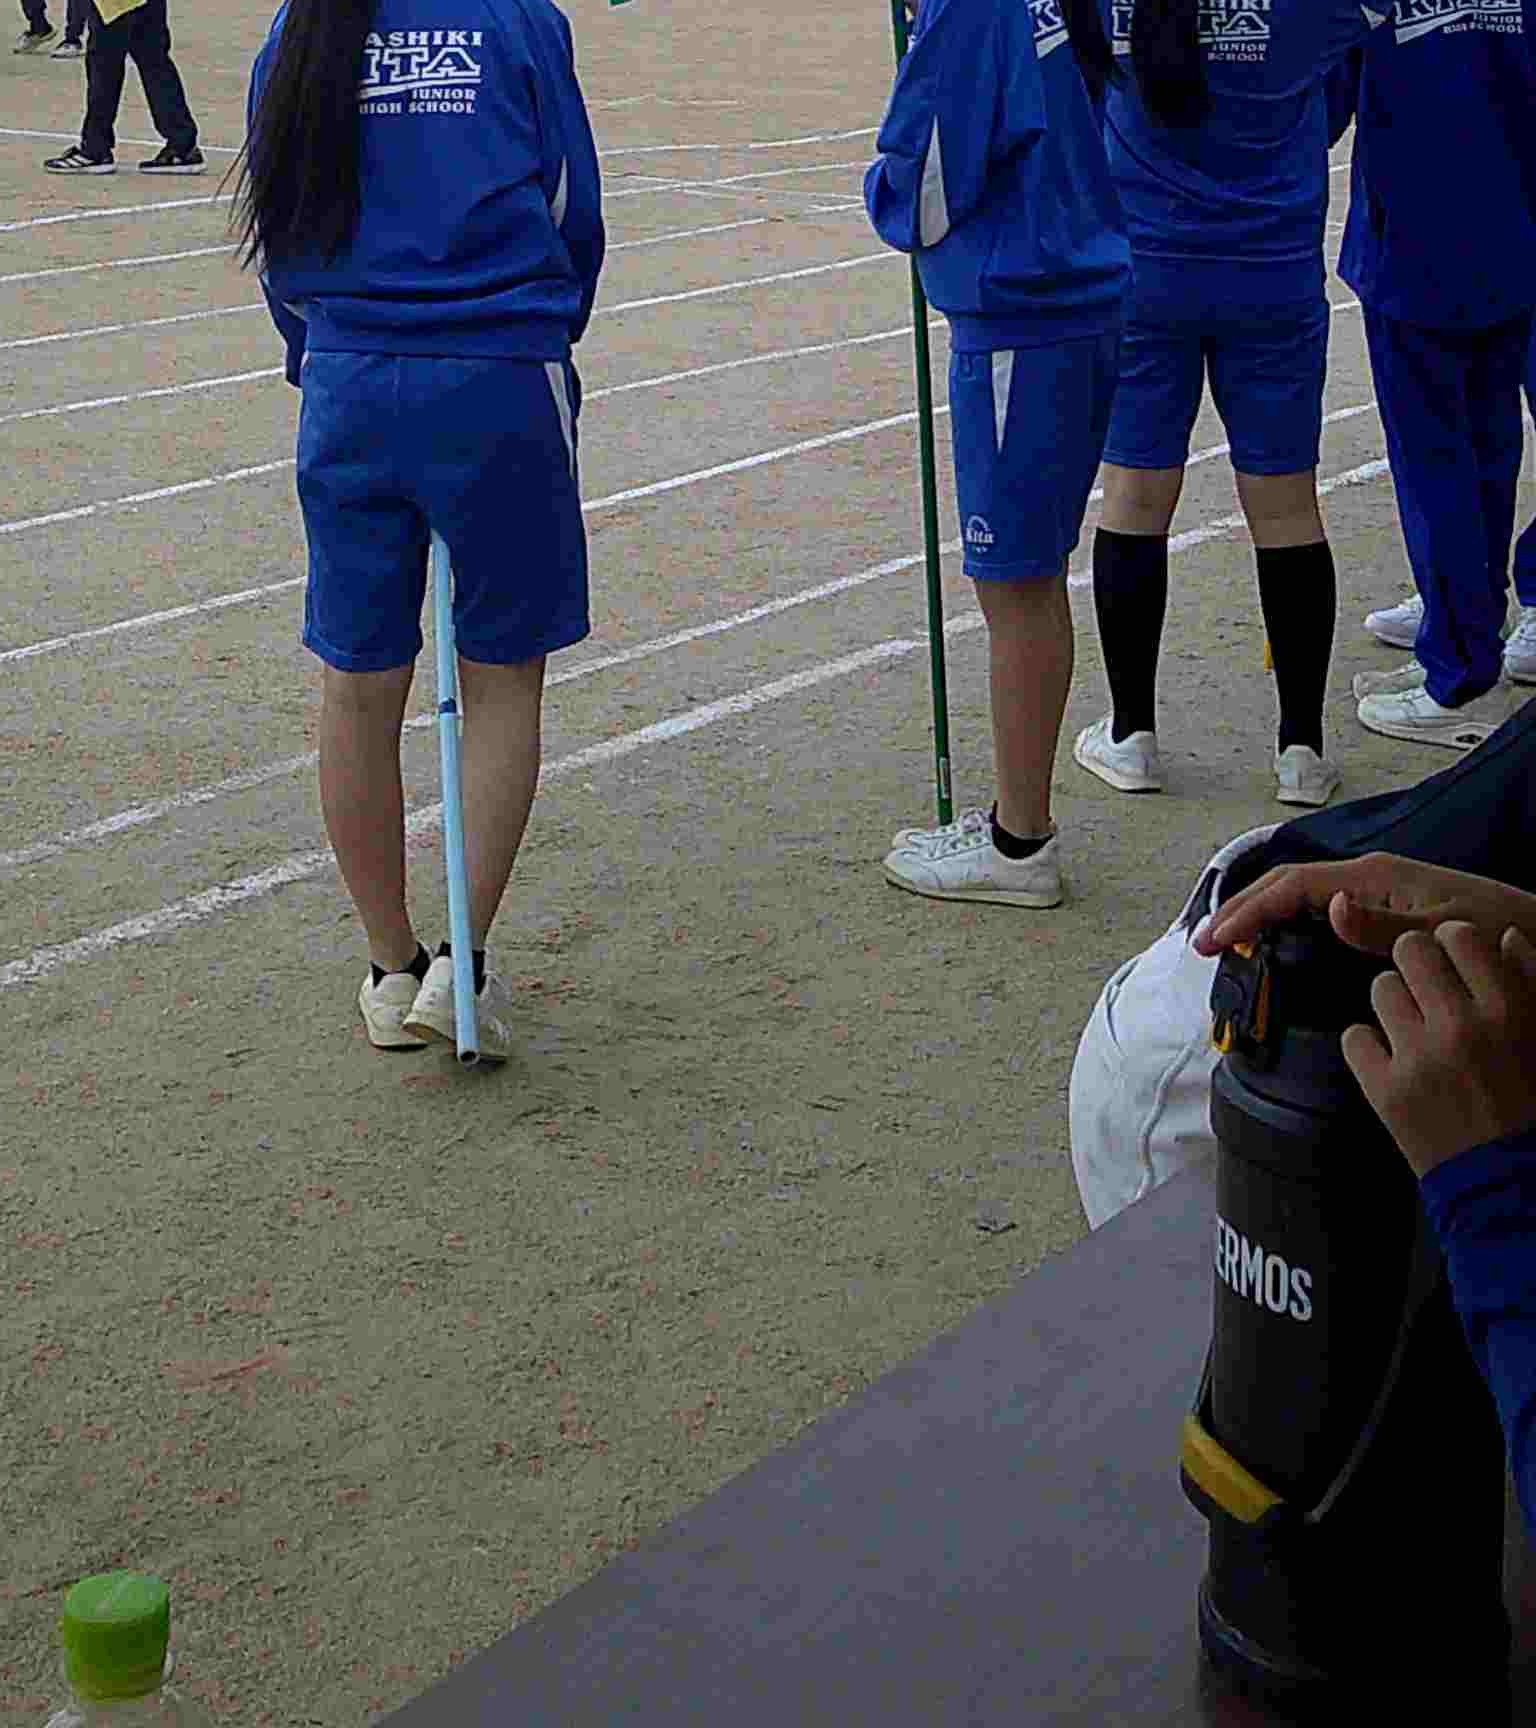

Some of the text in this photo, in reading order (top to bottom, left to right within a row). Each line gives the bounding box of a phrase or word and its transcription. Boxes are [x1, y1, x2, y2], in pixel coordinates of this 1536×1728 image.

[365, 30, 482, 47] ASHIKI
[413, 88, 477, 102] JUNIOR
[408, 101, 476, 114] SCHOOL
[1216, 1212, 1313, 1321] ERMOS
